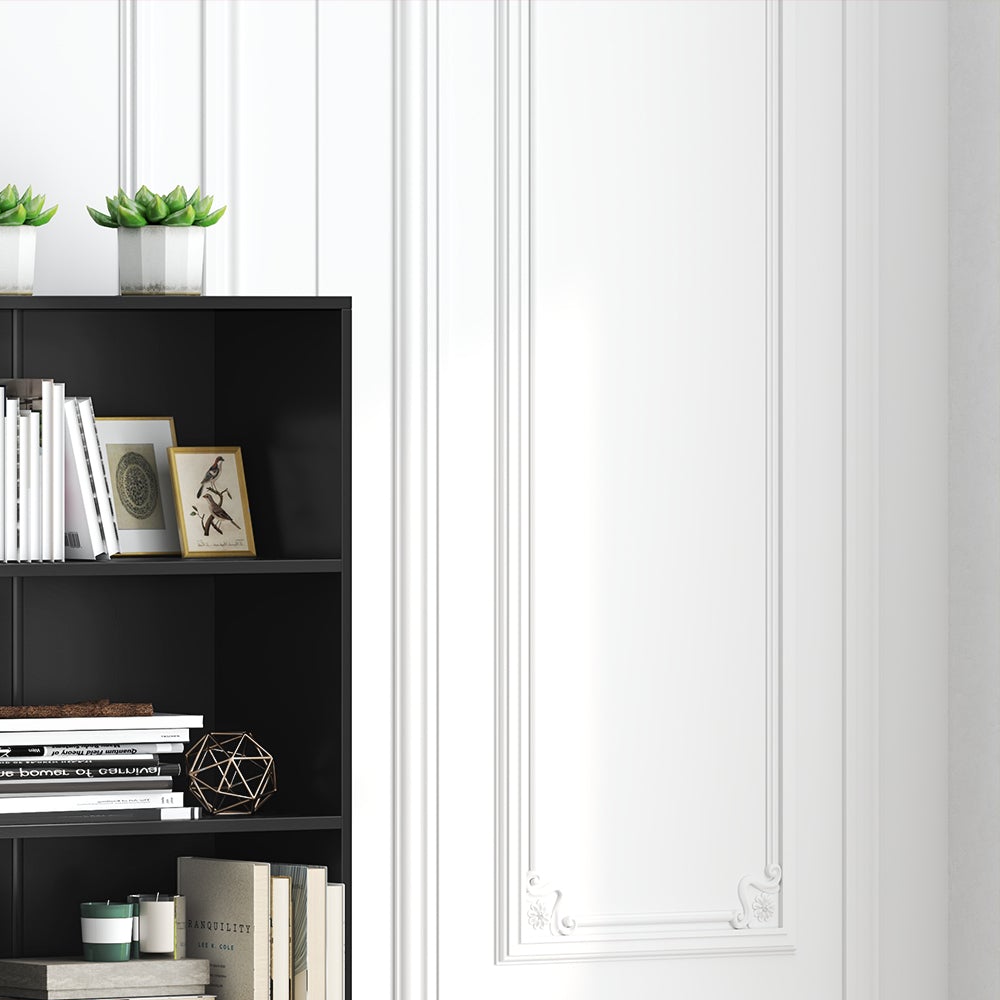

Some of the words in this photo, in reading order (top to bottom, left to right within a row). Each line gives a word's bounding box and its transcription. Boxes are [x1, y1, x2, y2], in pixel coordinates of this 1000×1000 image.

[51, 748, 59, 756] of
[60, 748, 81, 756] Theory
[82, 747, 103, 755] Field
[105, 747, 137, 755] Quantum
[188, 919, 250, 933] RANQUILITY
